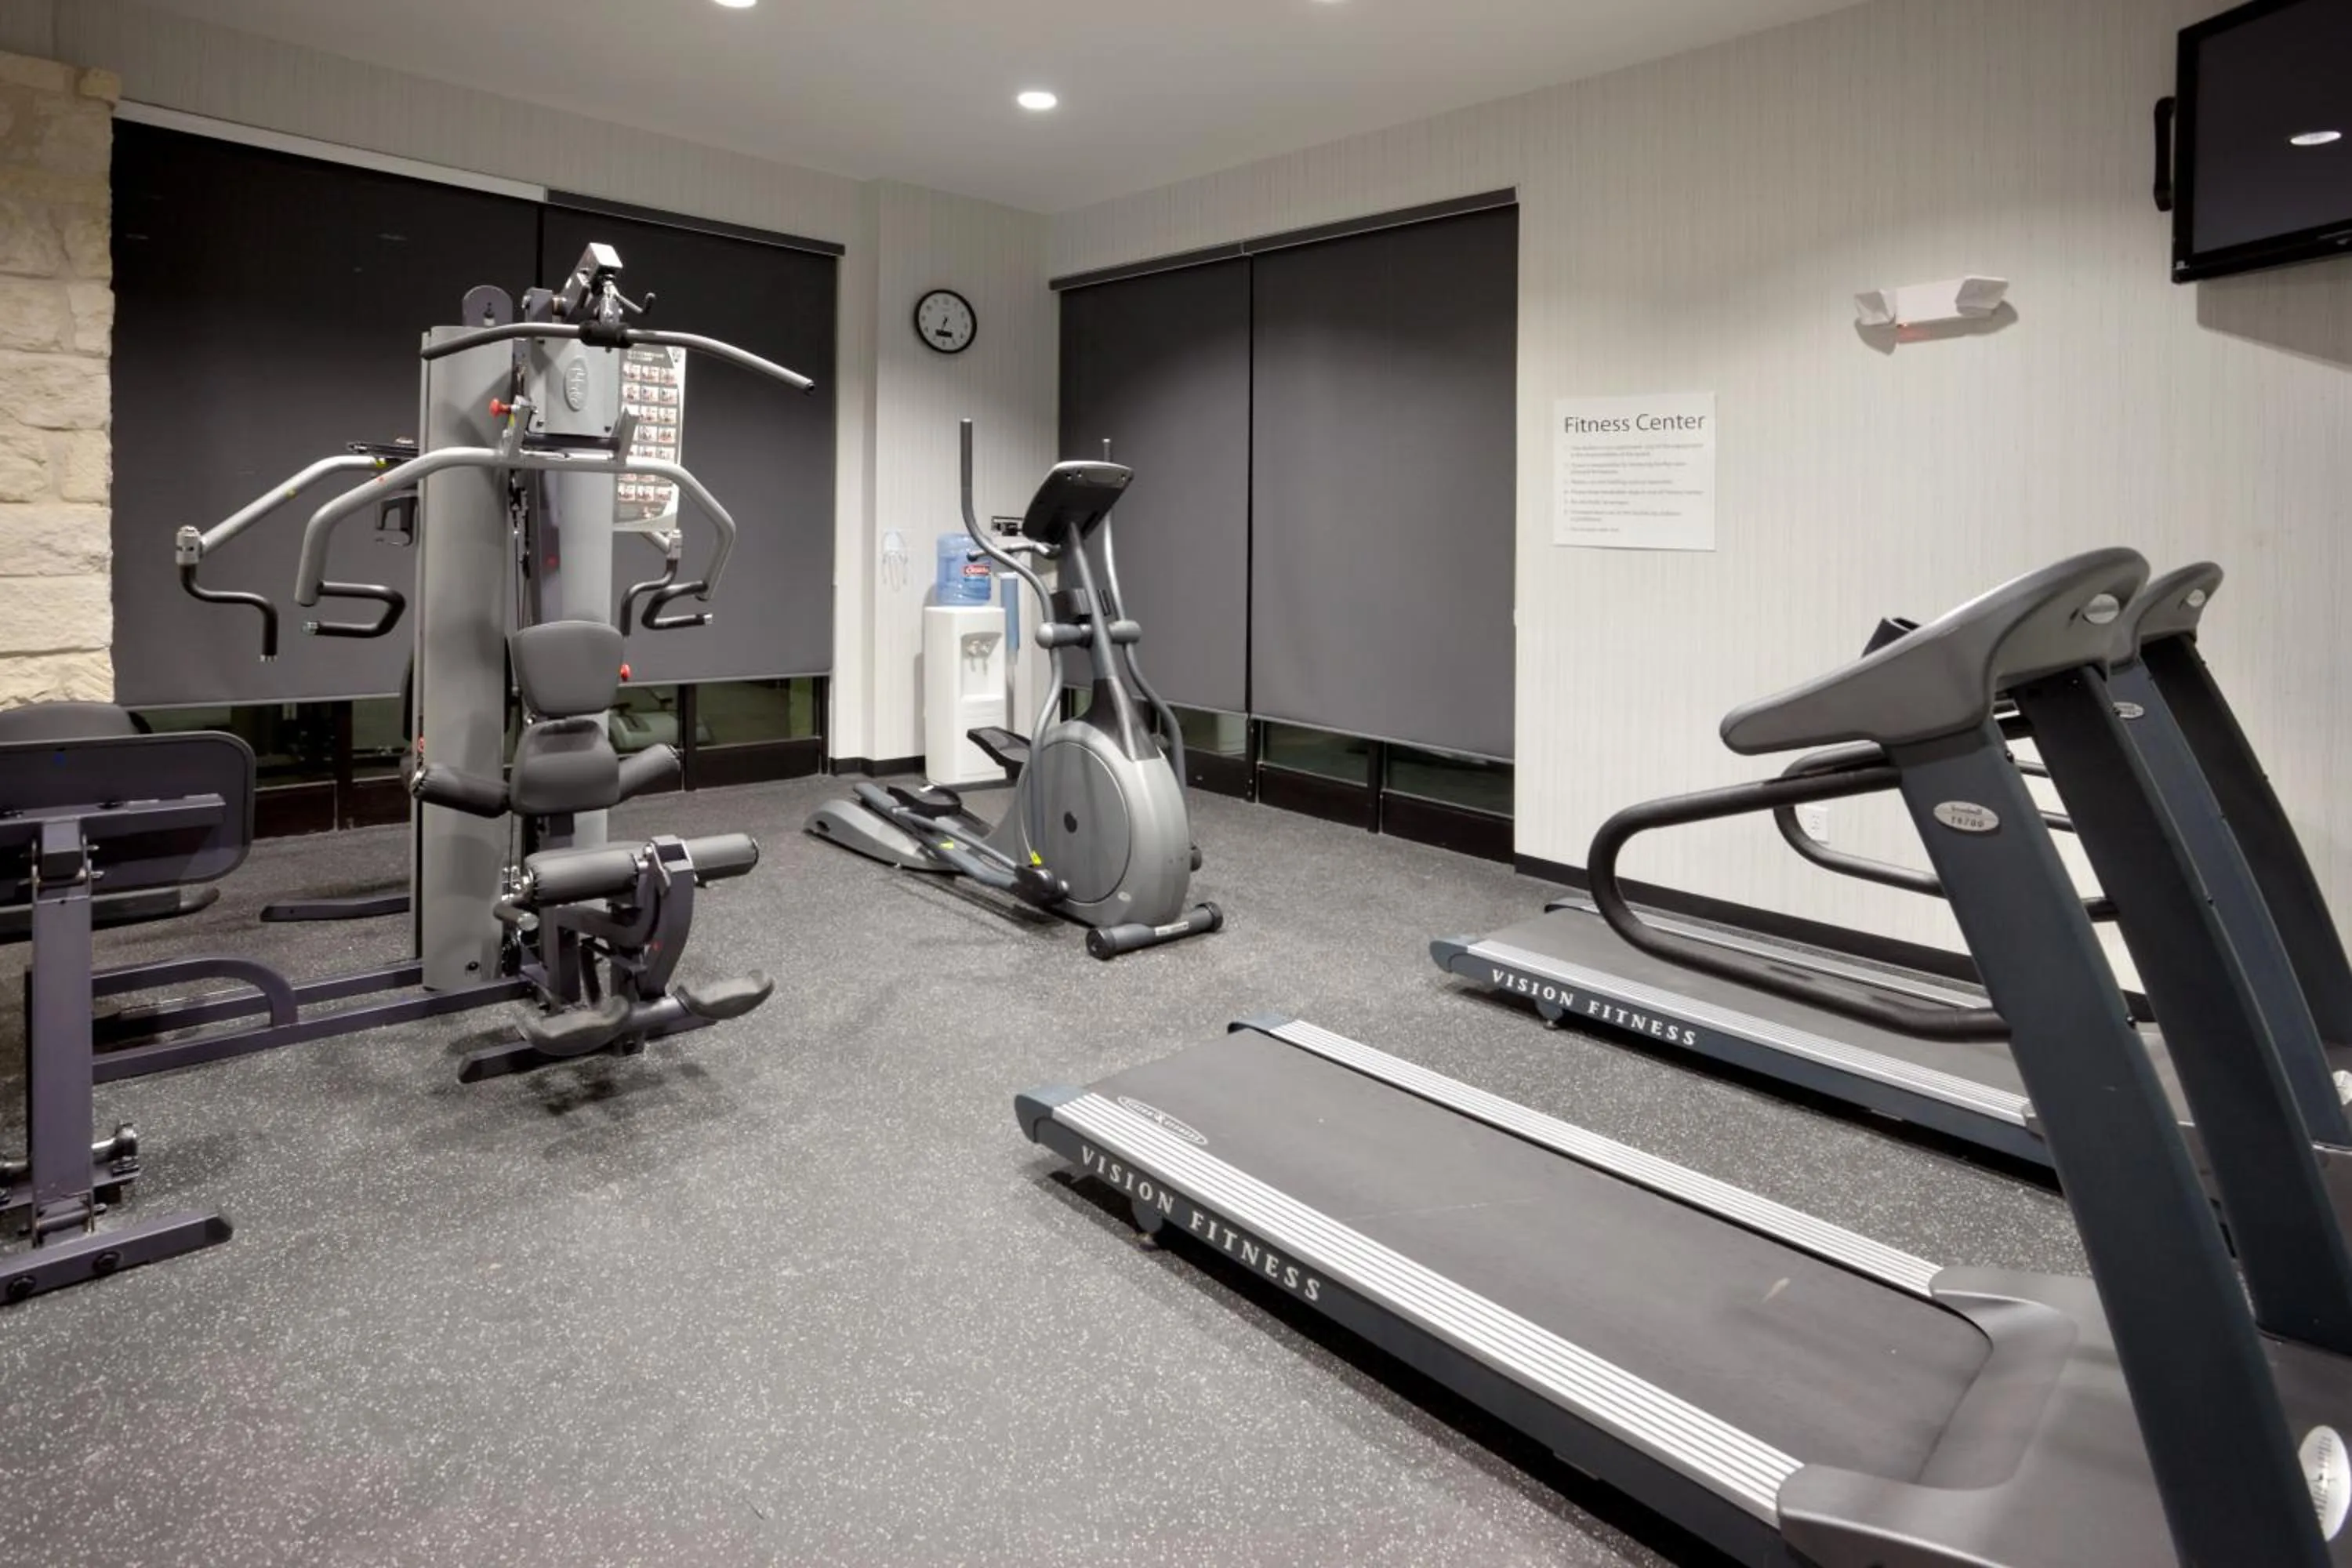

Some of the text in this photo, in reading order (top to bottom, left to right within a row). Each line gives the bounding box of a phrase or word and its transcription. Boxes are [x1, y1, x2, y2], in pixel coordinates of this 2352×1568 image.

[1563, 412, 1706, 434] Fitness Center
[1491, 968, 1697, 1047] VISION FITNESS
[1080, 1145, 1322, 1301] VISION FITNESS
